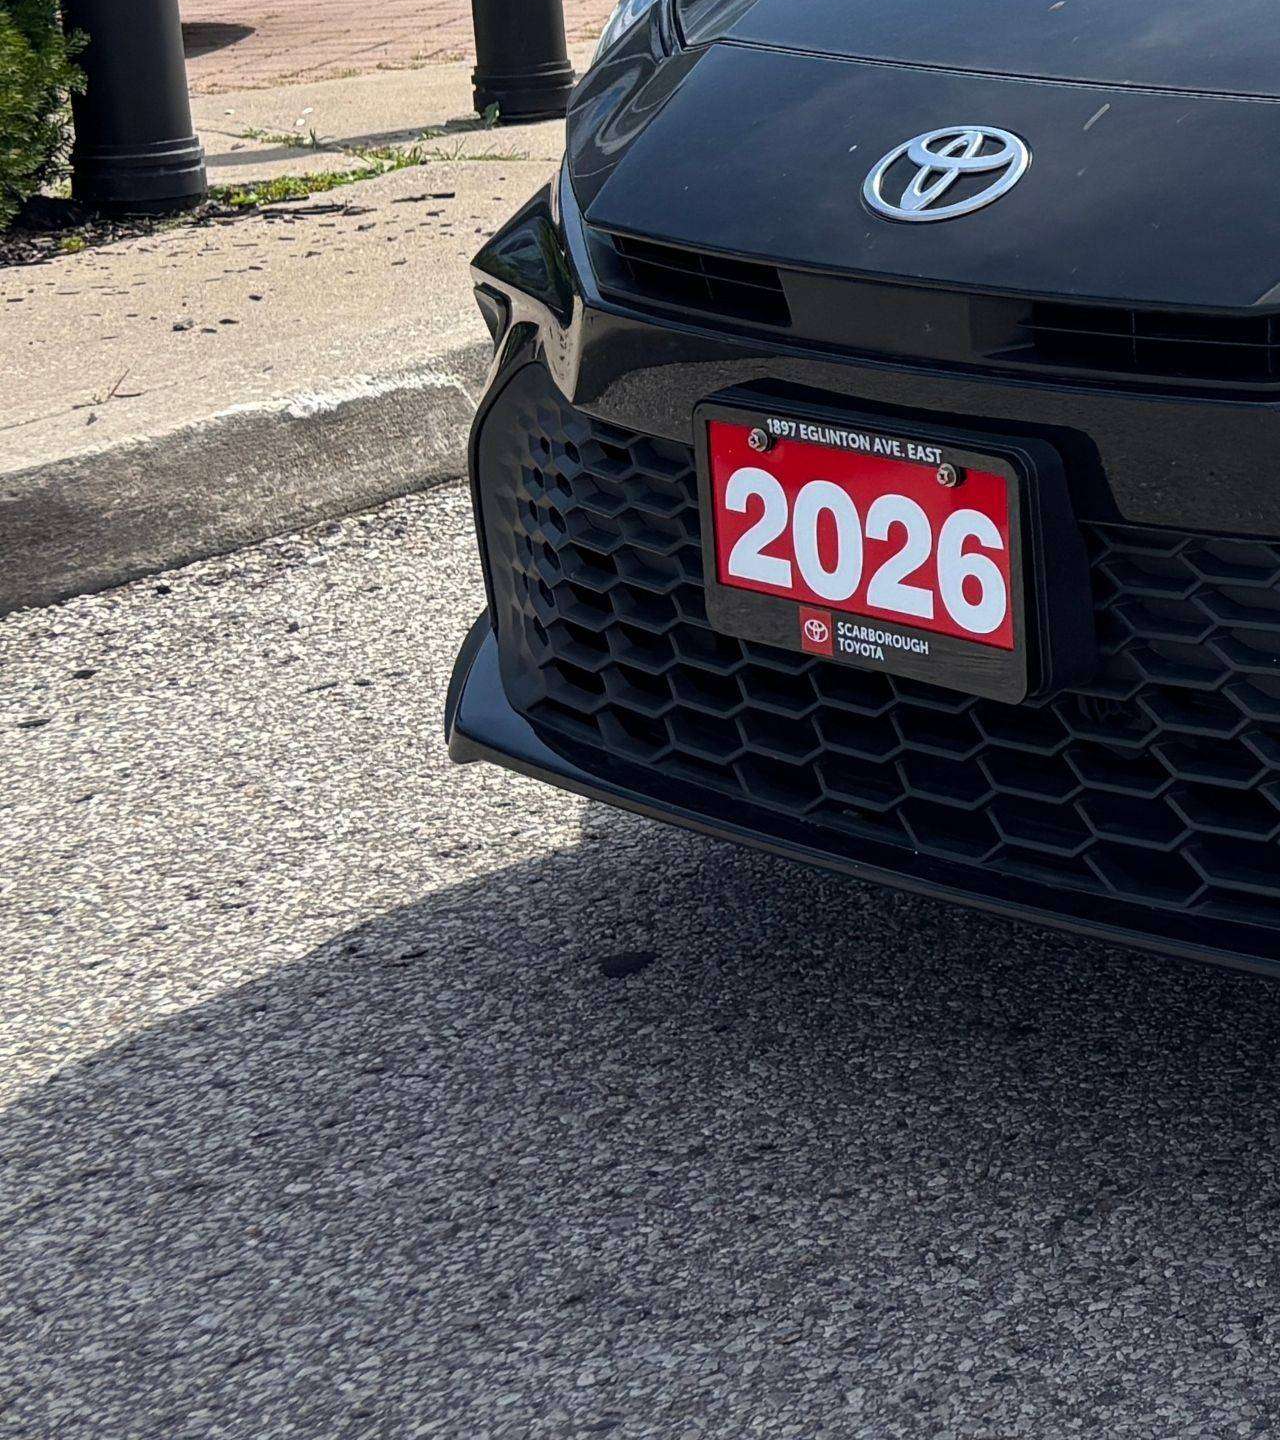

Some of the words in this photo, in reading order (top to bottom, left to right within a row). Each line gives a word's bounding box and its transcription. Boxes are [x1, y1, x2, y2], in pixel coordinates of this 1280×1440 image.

[766, 418, 797, 438] 1897
[799, 424, 870, 452] EGLINTON
[873, 436, 905, 458] AVE.
[907, 443, 942, 464] EAST
[725, 467, 1007, 634] 2026
[837, 620, 929, 655] SCARBOROUGH
[838, 637, 885, 661] TOYOTA
